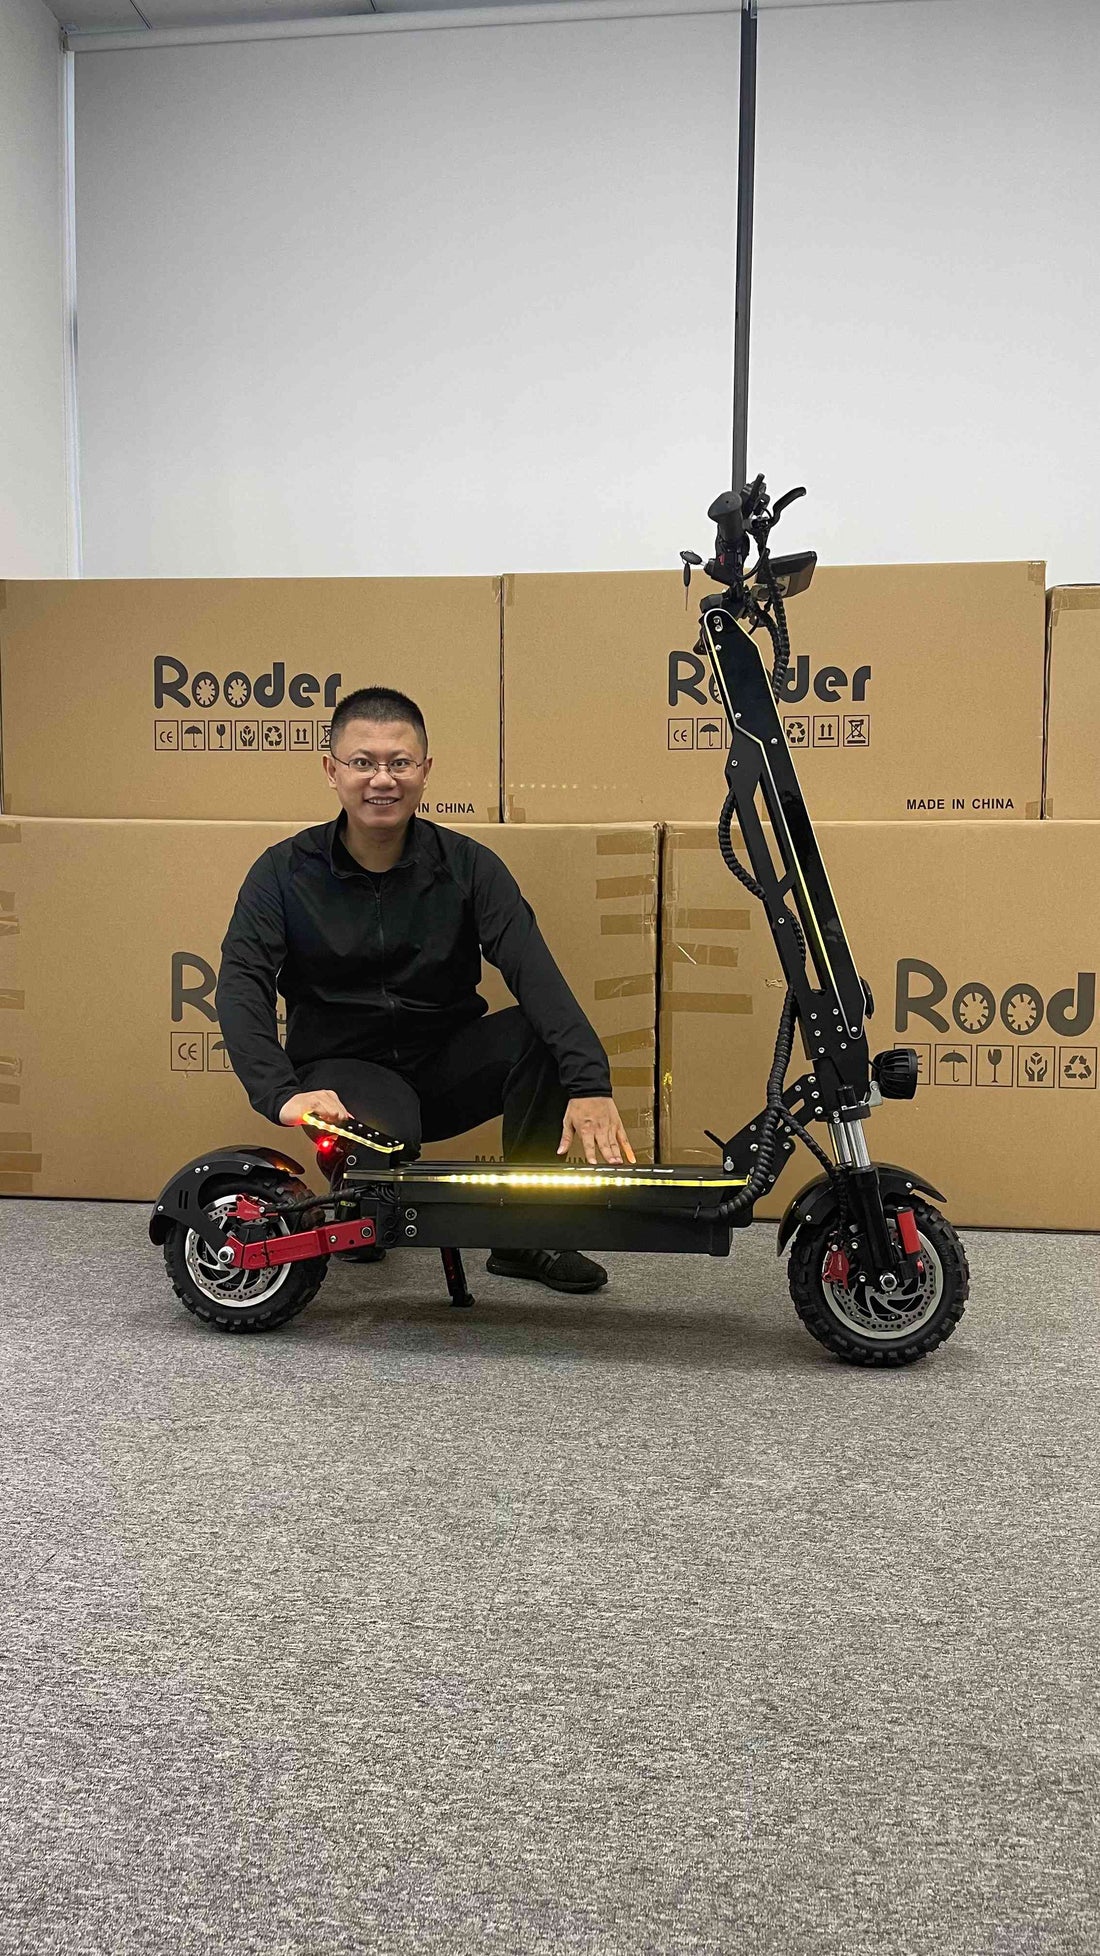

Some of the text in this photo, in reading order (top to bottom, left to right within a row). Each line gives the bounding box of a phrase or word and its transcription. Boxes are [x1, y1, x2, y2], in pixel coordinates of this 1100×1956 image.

[154, 655, 342, 709] Rooder
[668, 651, 872, 706] Rder
[418, 803, 475, 813] IN CHINA
[906, 798, 1014, 810] MADE IN CHINA
[177, 1042, 197, 1061] CE
